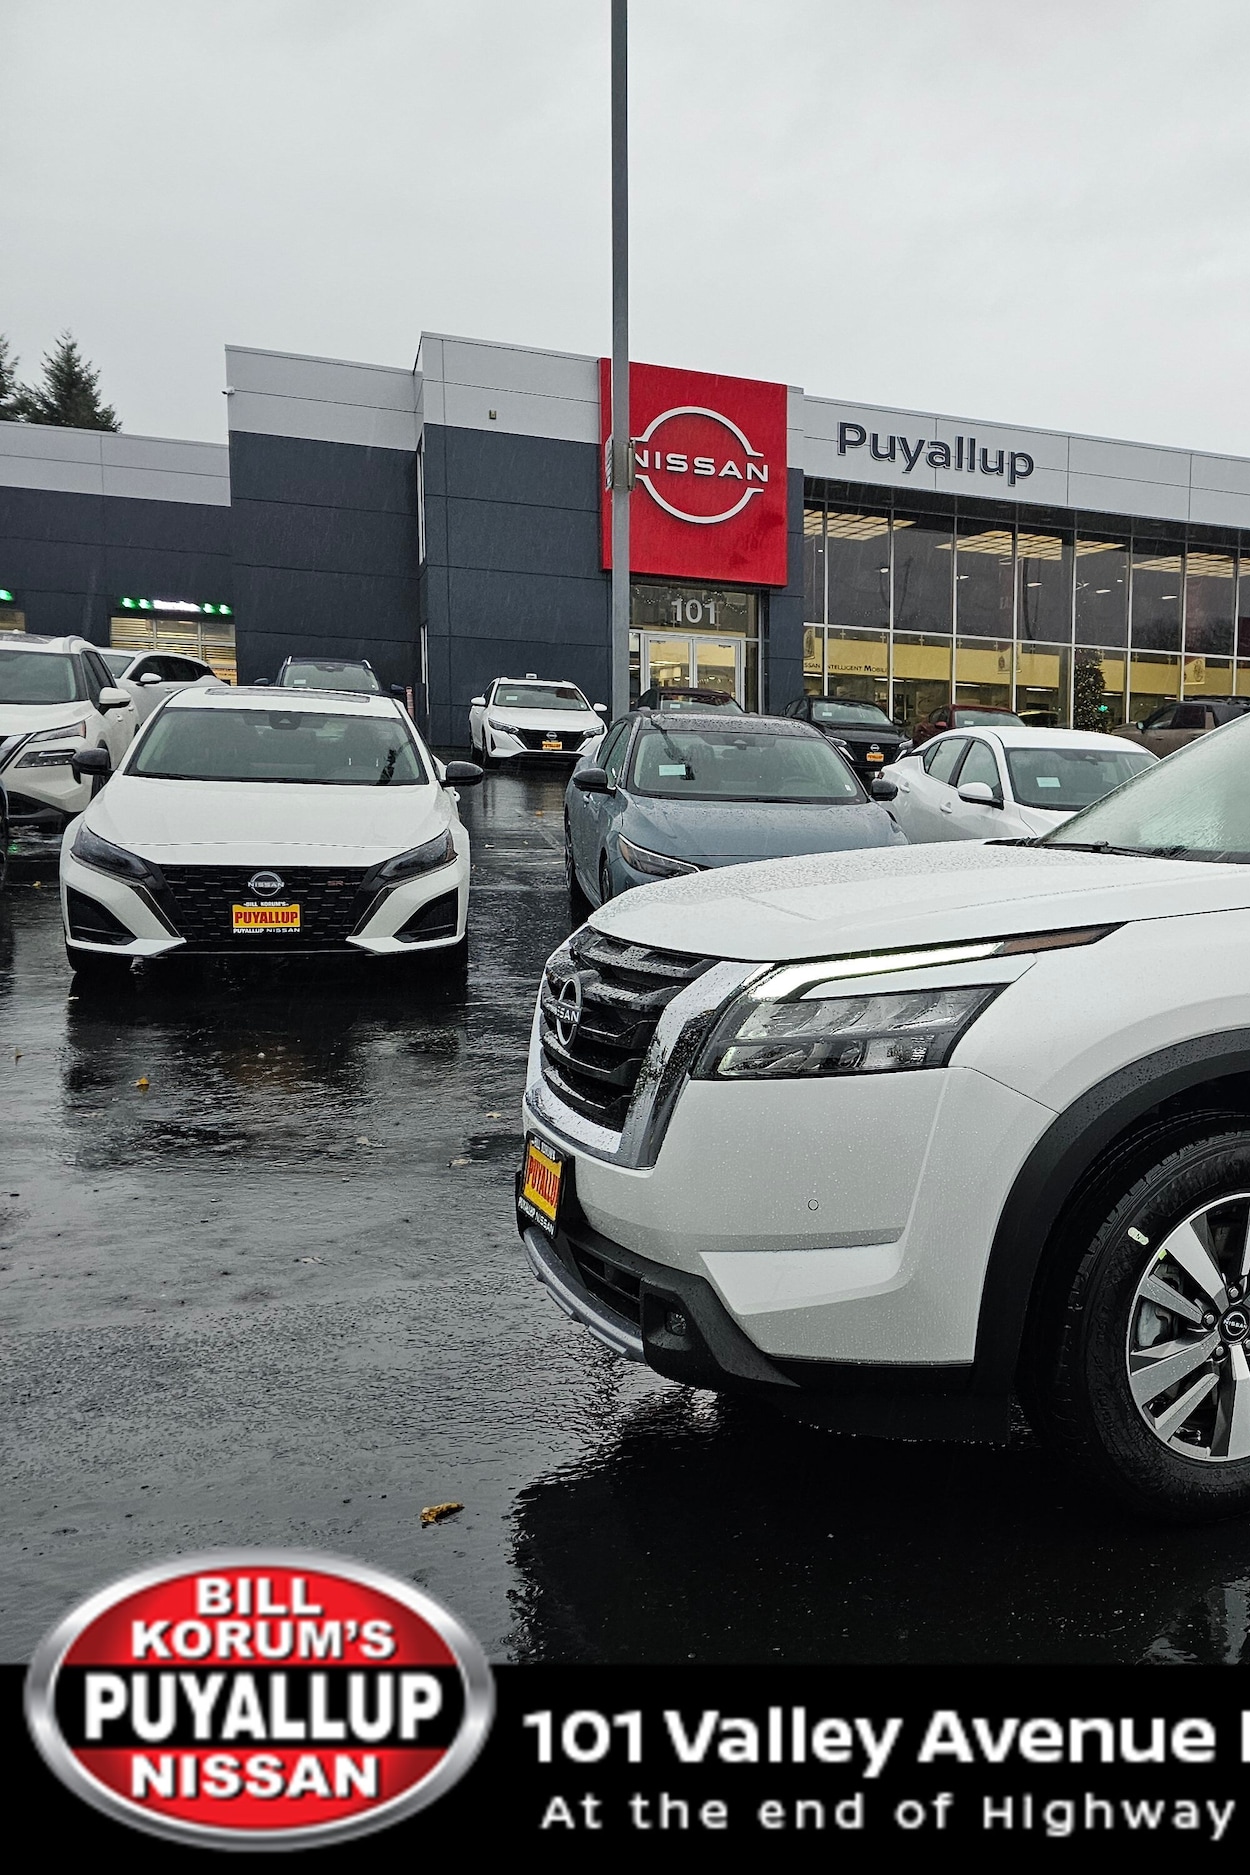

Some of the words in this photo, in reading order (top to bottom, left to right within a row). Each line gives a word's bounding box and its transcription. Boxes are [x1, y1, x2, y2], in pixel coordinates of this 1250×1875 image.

[634, 449, 769, 483] NISSAN
[837, 421, 1035, 487] Puyallup
[671, 598, 716, 625] 101
[234, 911, 299, 924] PUYALLUP
